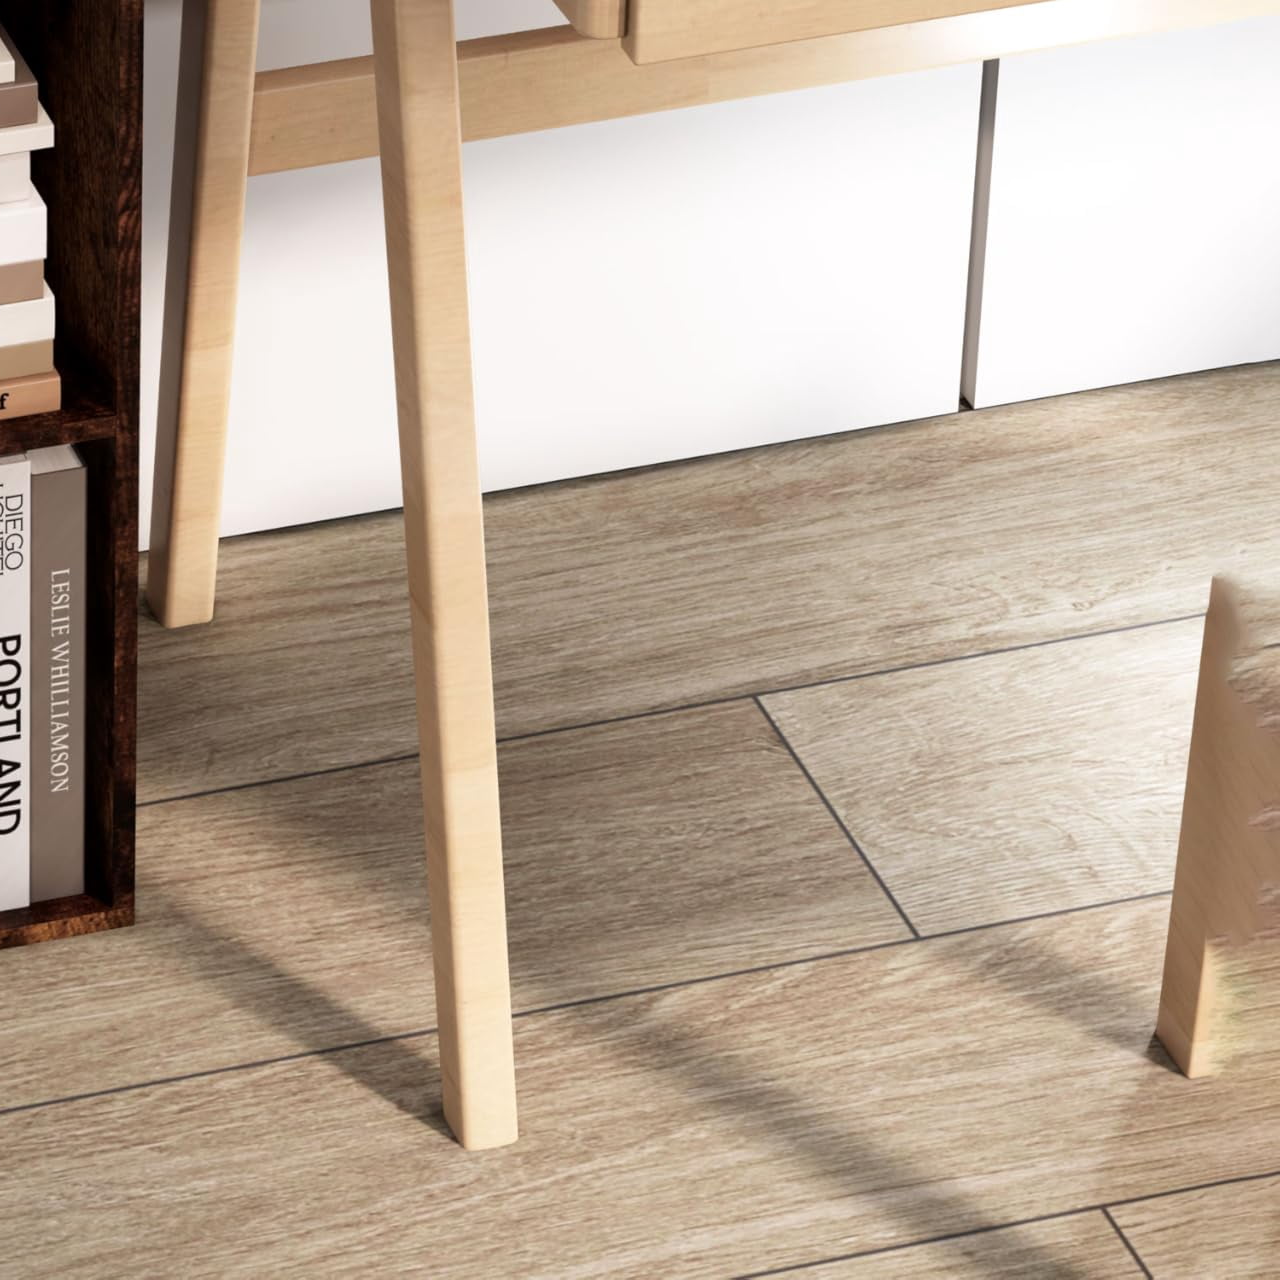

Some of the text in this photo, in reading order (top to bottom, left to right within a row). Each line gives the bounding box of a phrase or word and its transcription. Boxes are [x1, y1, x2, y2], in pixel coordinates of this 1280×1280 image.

[3, 492, 24, 572] DIEGO
[49, 567, 71, 794] LESLIE WHILLIAMSON
